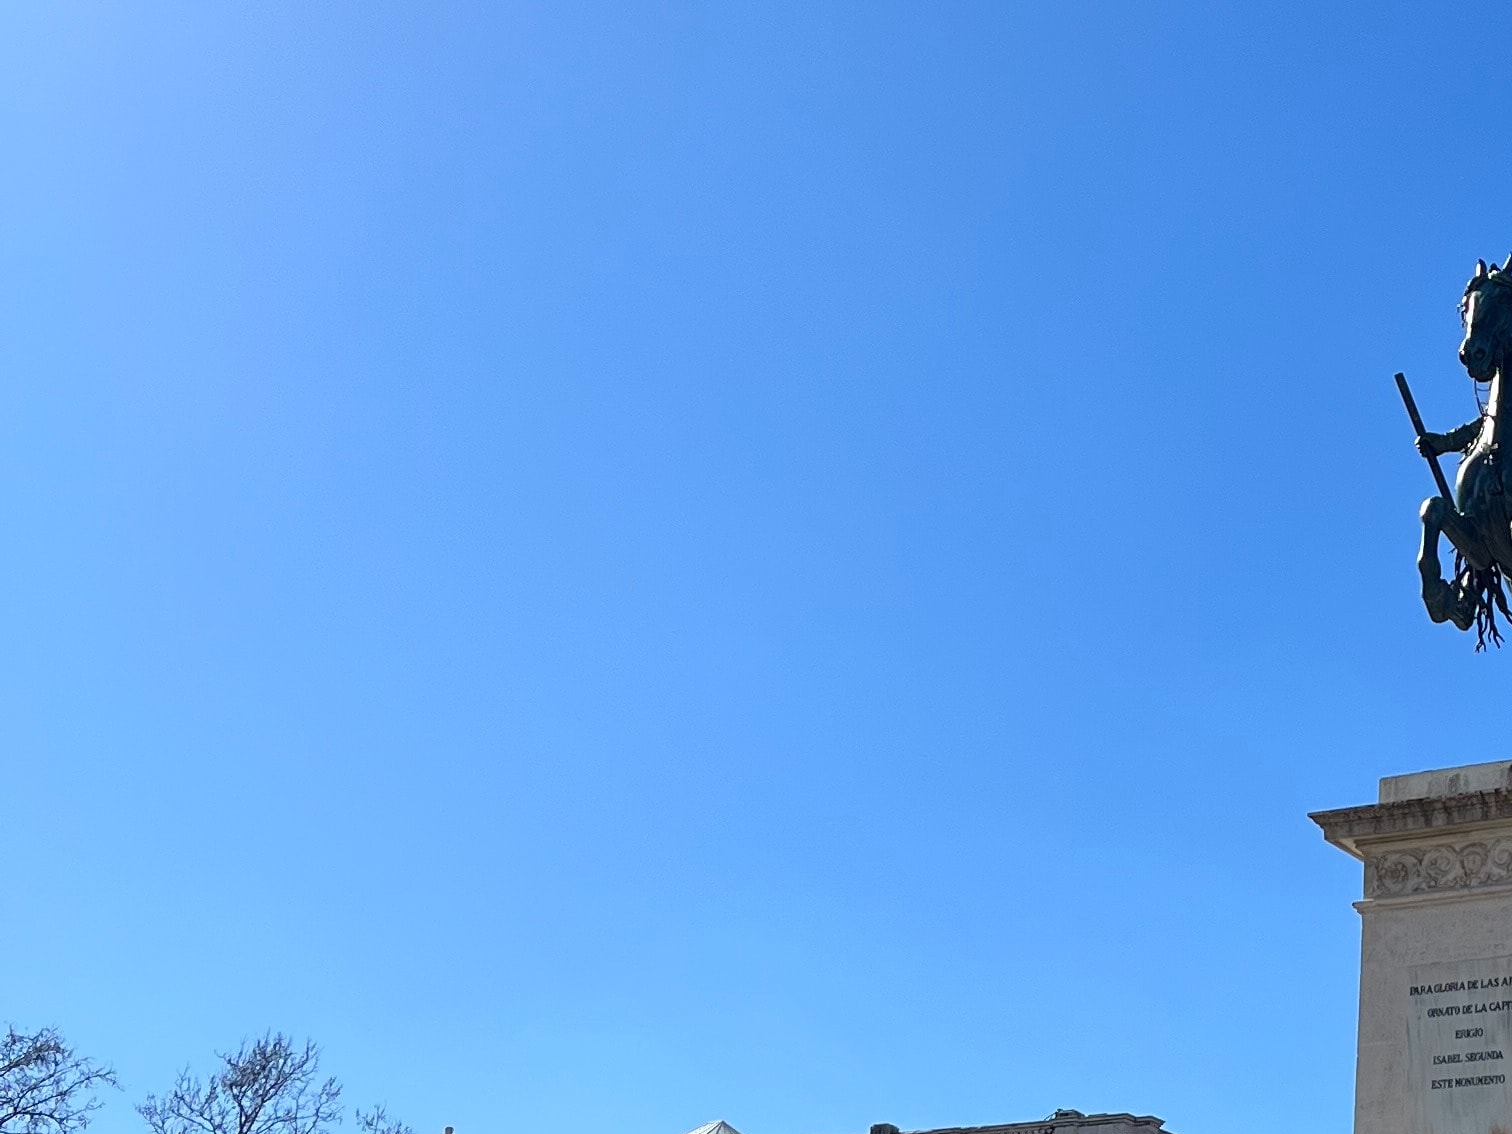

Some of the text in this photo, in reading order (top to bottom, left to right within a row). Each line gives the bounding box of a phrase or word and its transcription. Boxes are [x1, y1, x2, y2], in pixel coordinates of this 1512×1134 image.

[1410, 985, 1433, 996] PARA
[1434, 981, 1466, 993] GLORIA
[1467, 979, 1479, 990] DE
[1480, 977, 1500, 989] LAS
[1427, 1007, 1460, 1018] ORNATO
[1462, 1005, 1473, 1014] DE
[1475, 1003, 1487, 1013] LA
[1433, 1050, 1503, 1065] ISABEL SEGUNDA
[1431, 1074, 1505, 1090] ESTE MONUMENTO
